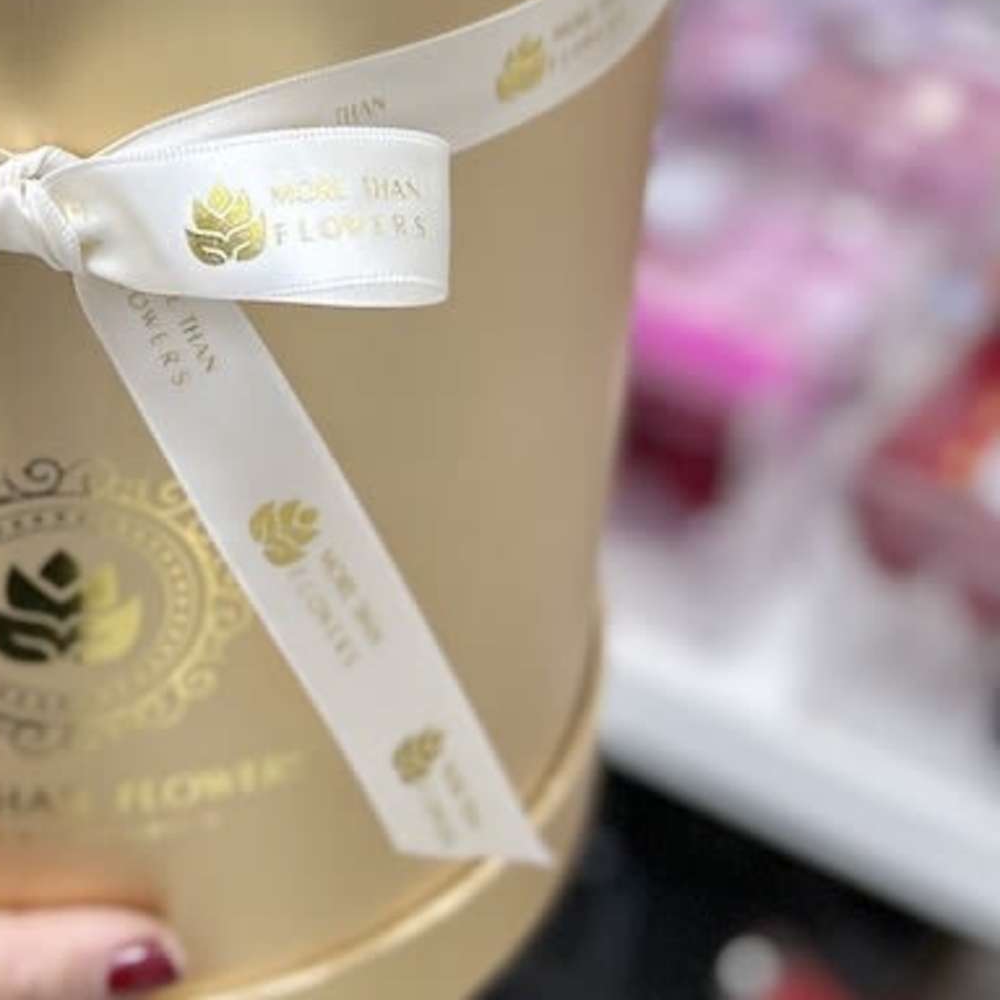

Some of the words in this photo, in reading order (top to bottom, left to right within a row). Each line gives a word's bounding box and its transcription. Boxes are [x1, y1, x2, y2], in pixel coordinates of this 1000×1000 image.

[361, 174, 422, 200] THAN
[273, 211, 428, 247] FLOWERS
[177, 313, 216, 374] THAN
